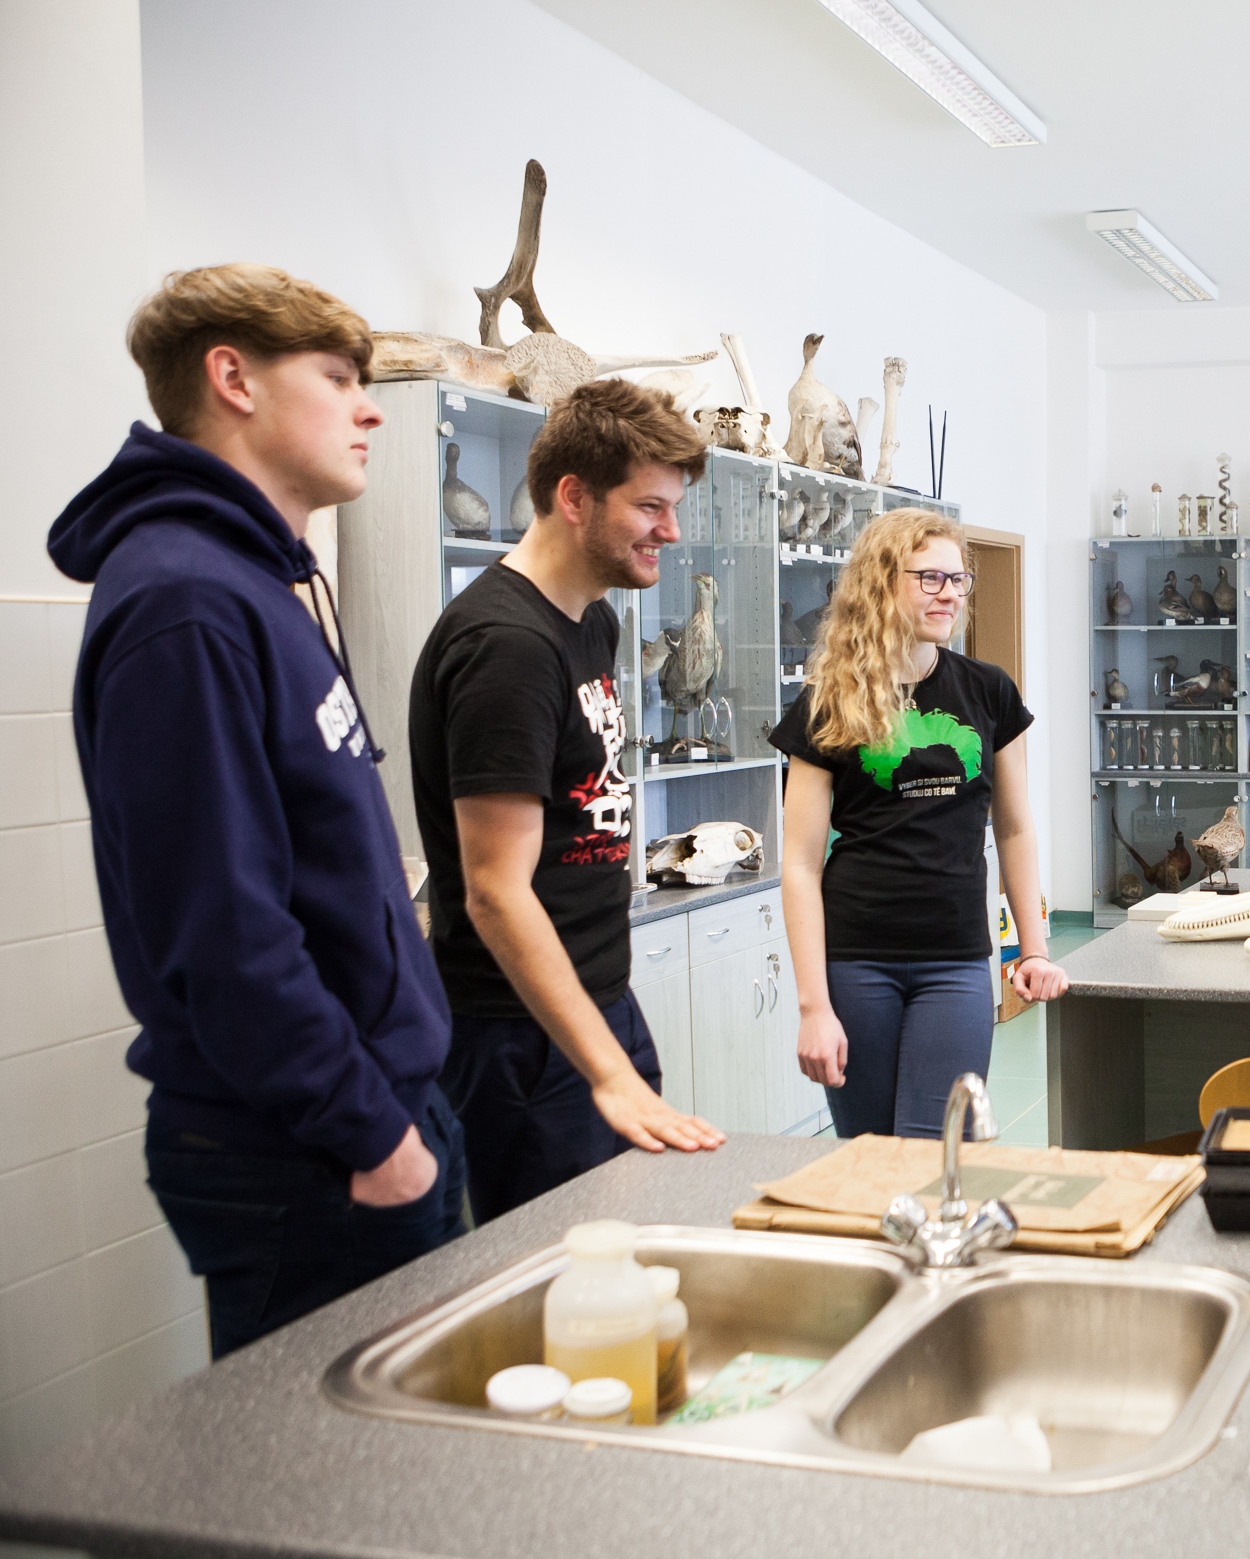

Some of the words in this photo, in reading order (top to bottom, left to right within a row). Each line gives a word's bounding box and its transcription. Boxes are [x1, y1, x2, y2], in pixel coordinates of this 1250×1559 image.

[898, 780, 916, 791] VYBER
[924, 777, 939, 785] SVOU
[941, 776, 962, 784] BARVU.
[902, 789, 923, 798] STUDUJ
[925, 788, 932, 796] CO
